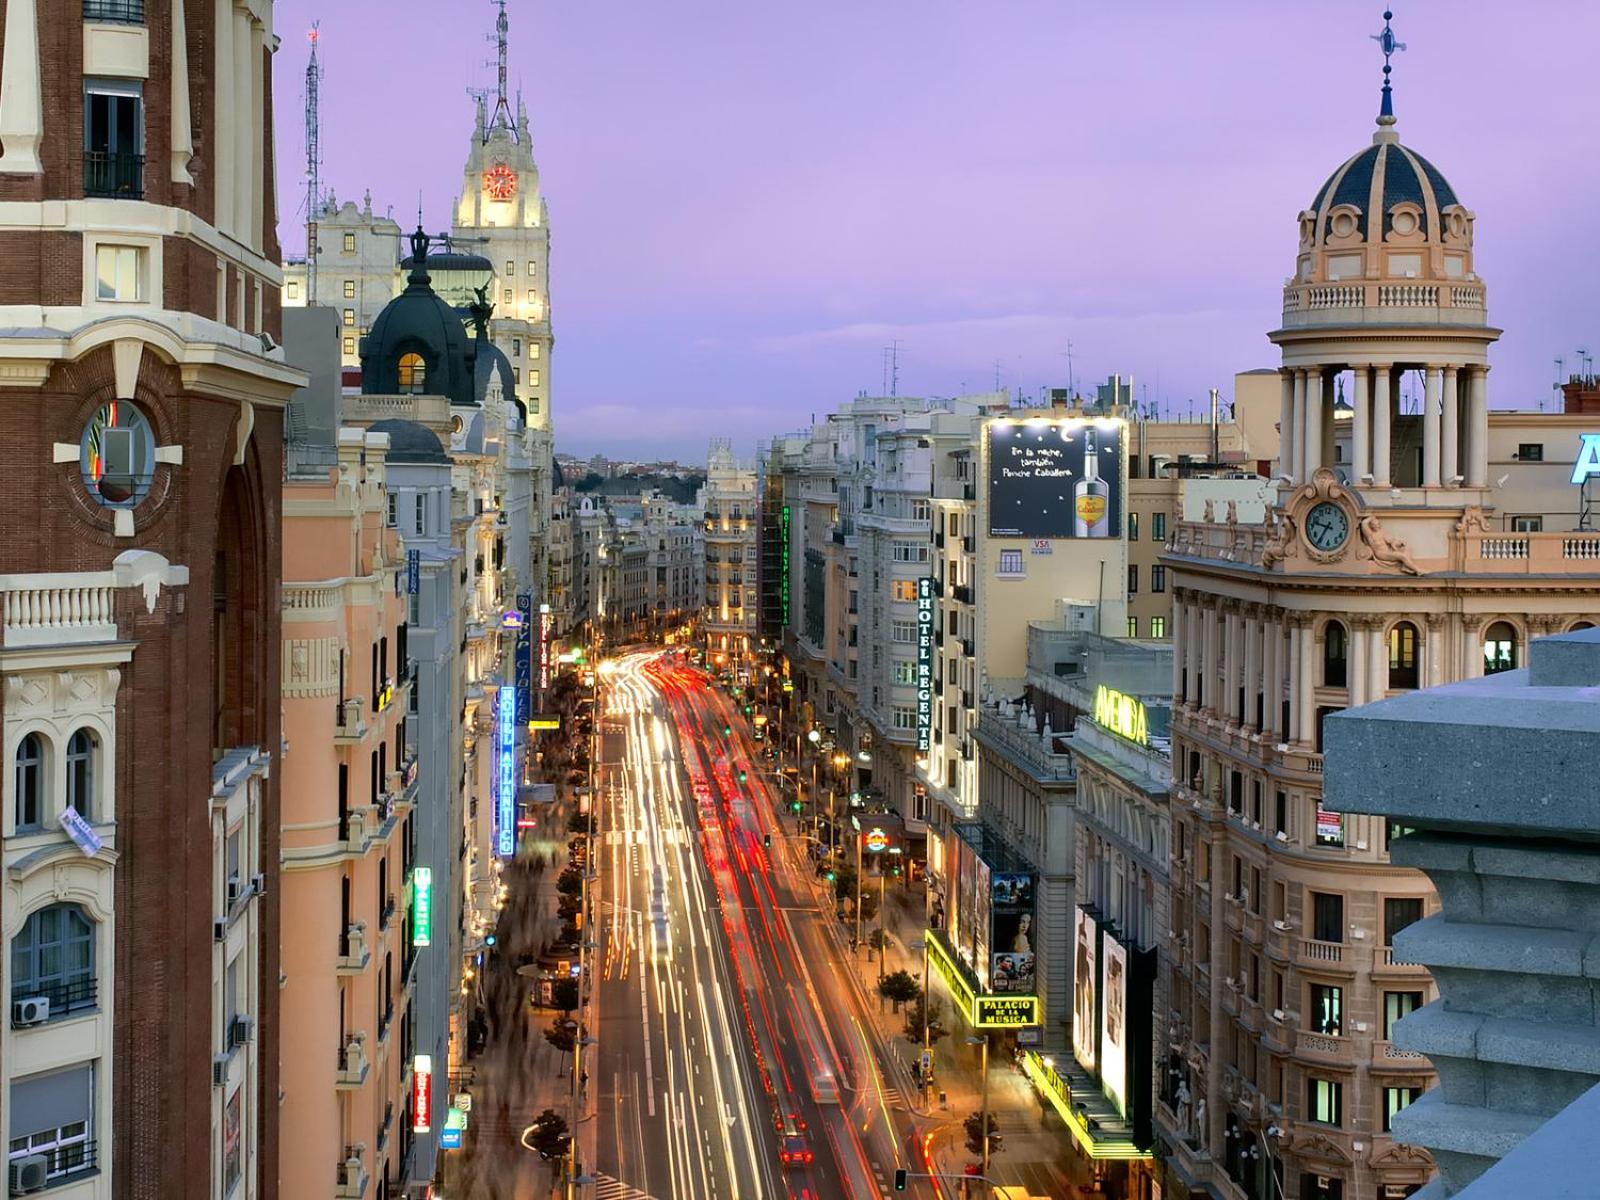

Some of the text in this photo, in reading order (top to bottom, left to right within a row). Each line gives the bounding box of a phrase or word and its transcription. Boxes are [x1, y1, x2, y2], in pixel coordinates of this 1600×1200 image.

[918, 598, 931, 750] HOTEL REGENTE
[502, 688, 513, 746] HOTEL
[983, 1000, 1031, 1009] PALACIO
[985, 1015, 1028, 1023] MUSICA
